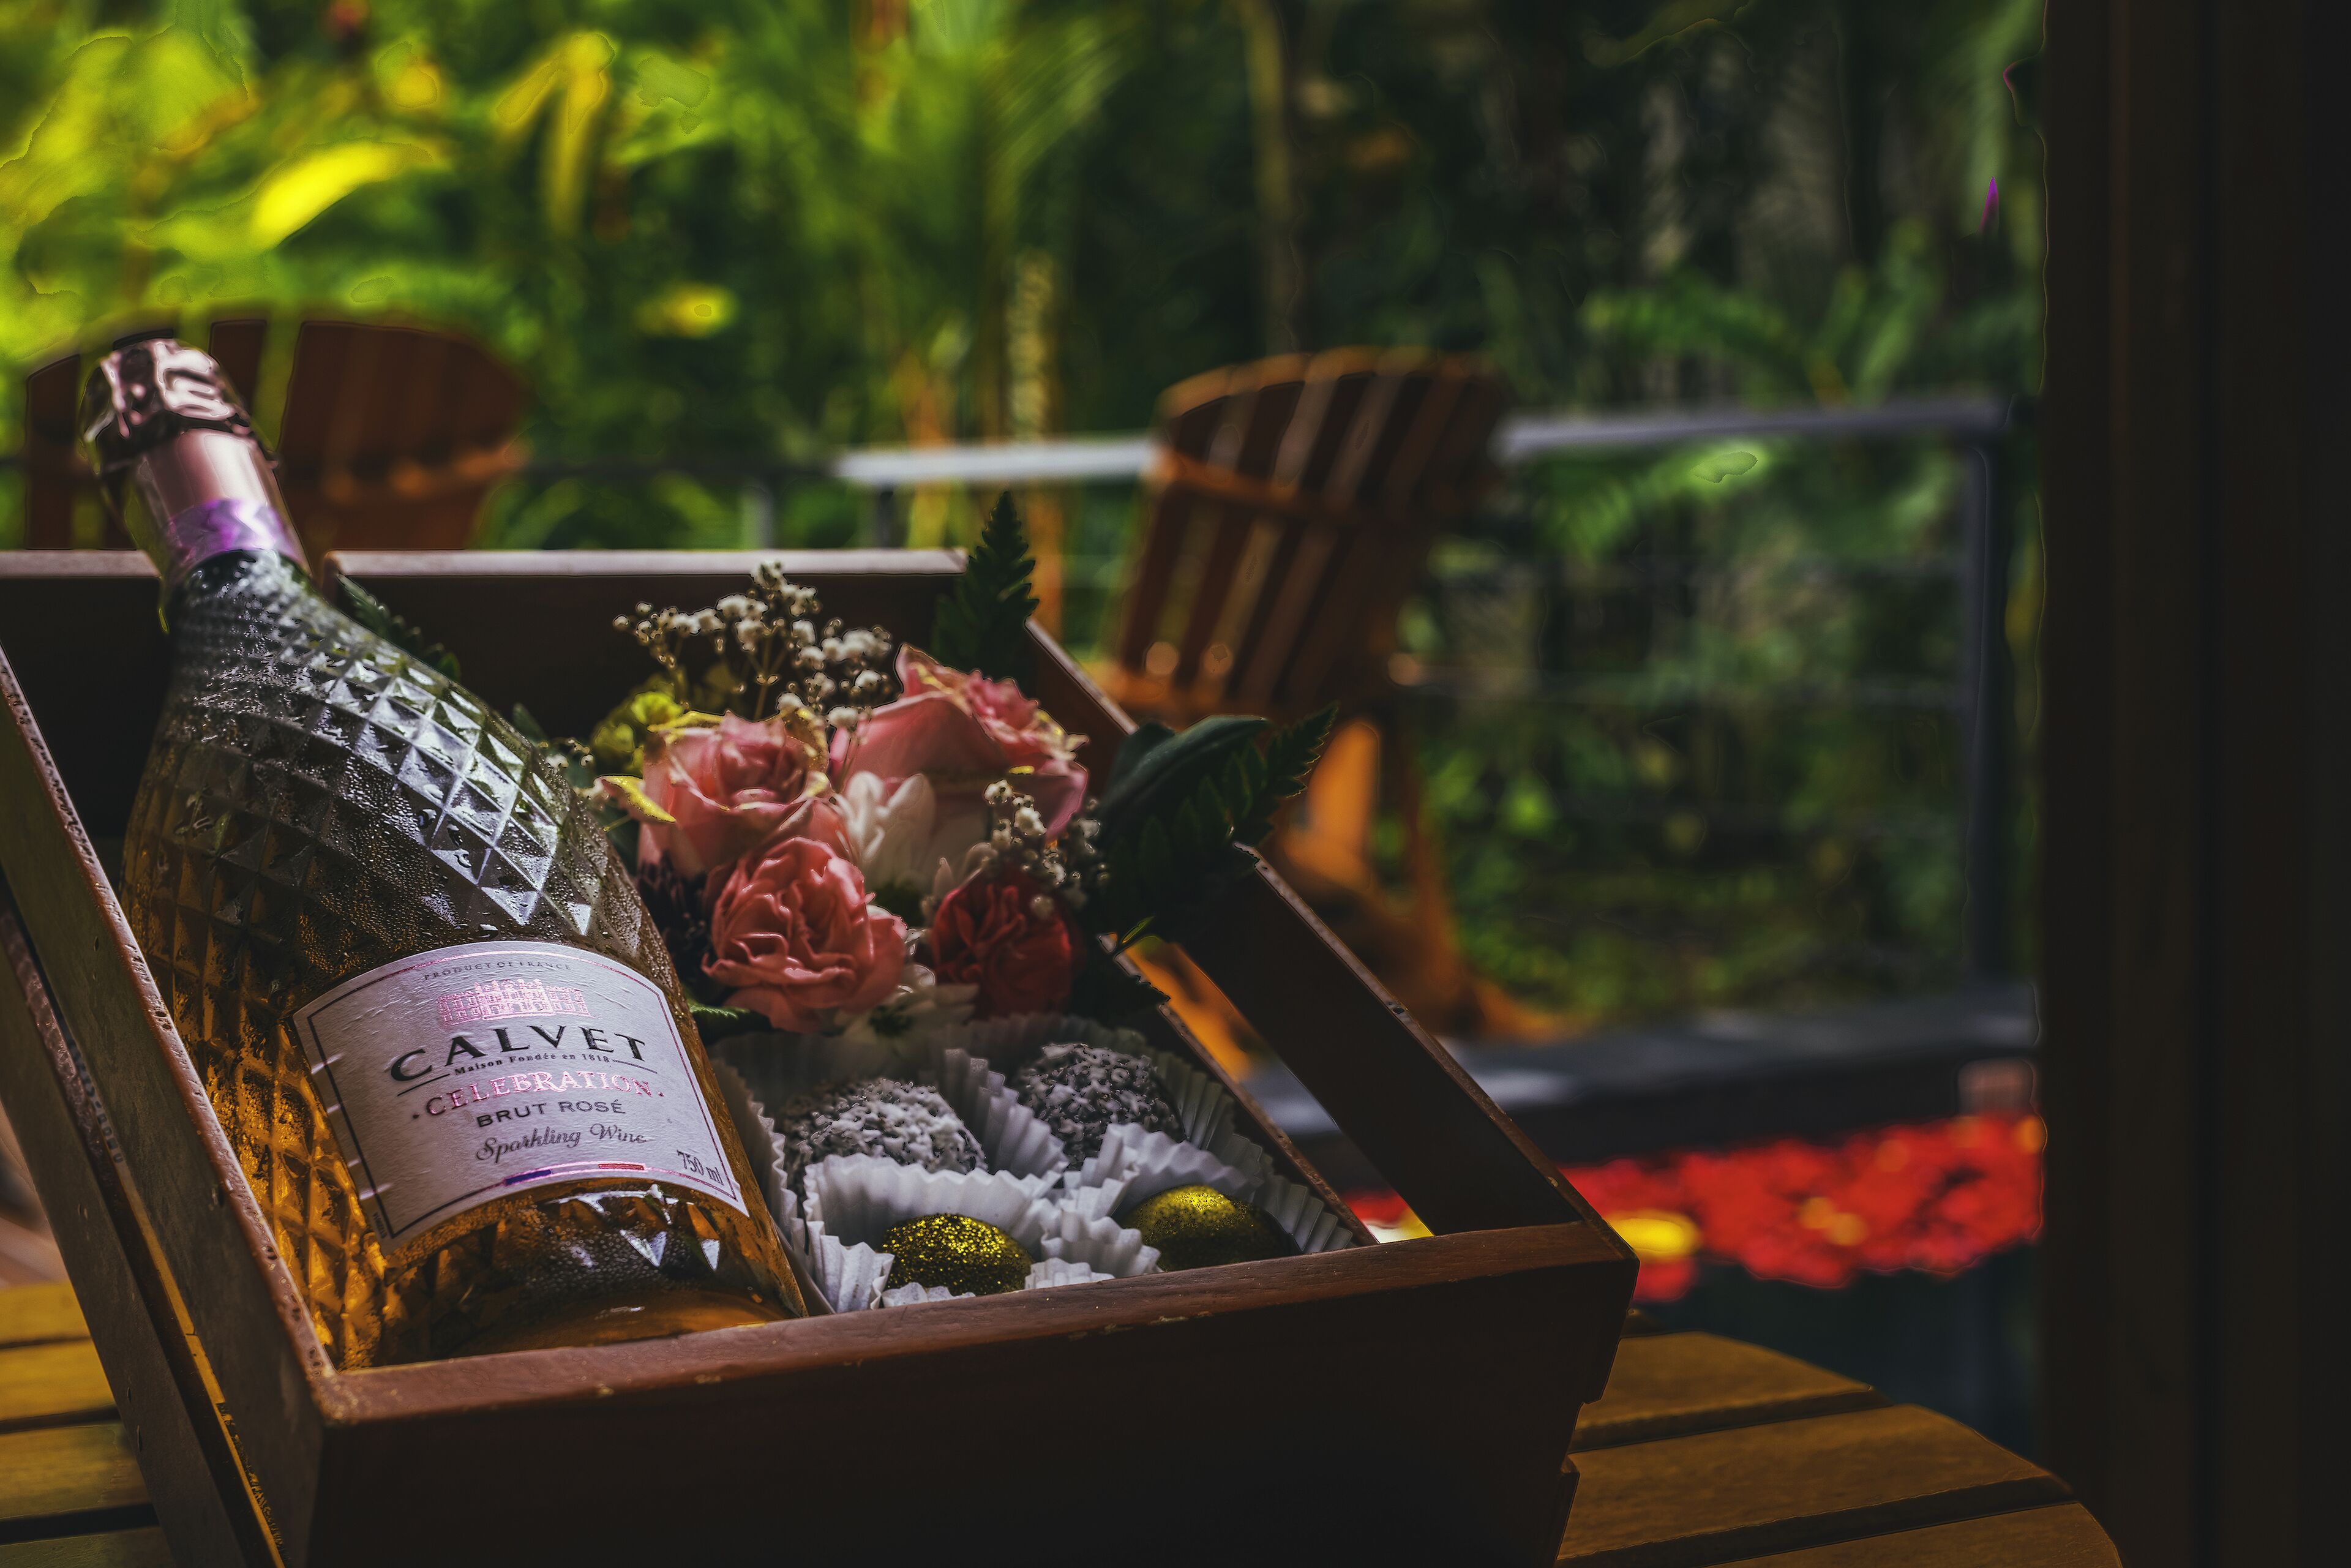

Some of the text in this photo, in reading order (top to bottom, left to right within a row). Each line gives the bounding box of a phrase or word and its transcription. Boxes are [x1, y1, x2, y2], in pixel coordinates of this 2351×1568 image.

[424, 963, 490, 980] PRODUCT
[391, 1025, 646, 1081] CALVET
[455, 1059, 503, 1076] Maison
[509, 1052, 557, 1063] Fondée
[582, 1053, 610, 1063] 1818
[426, 1071, 653, 1117] CELEBRATION
[476, 1099, 626, 1128] BRUT ROSÉ
[476, 1123, 647, 1164] Sparkling Wine
[677, 1149, 725, 1187] 750 ml
